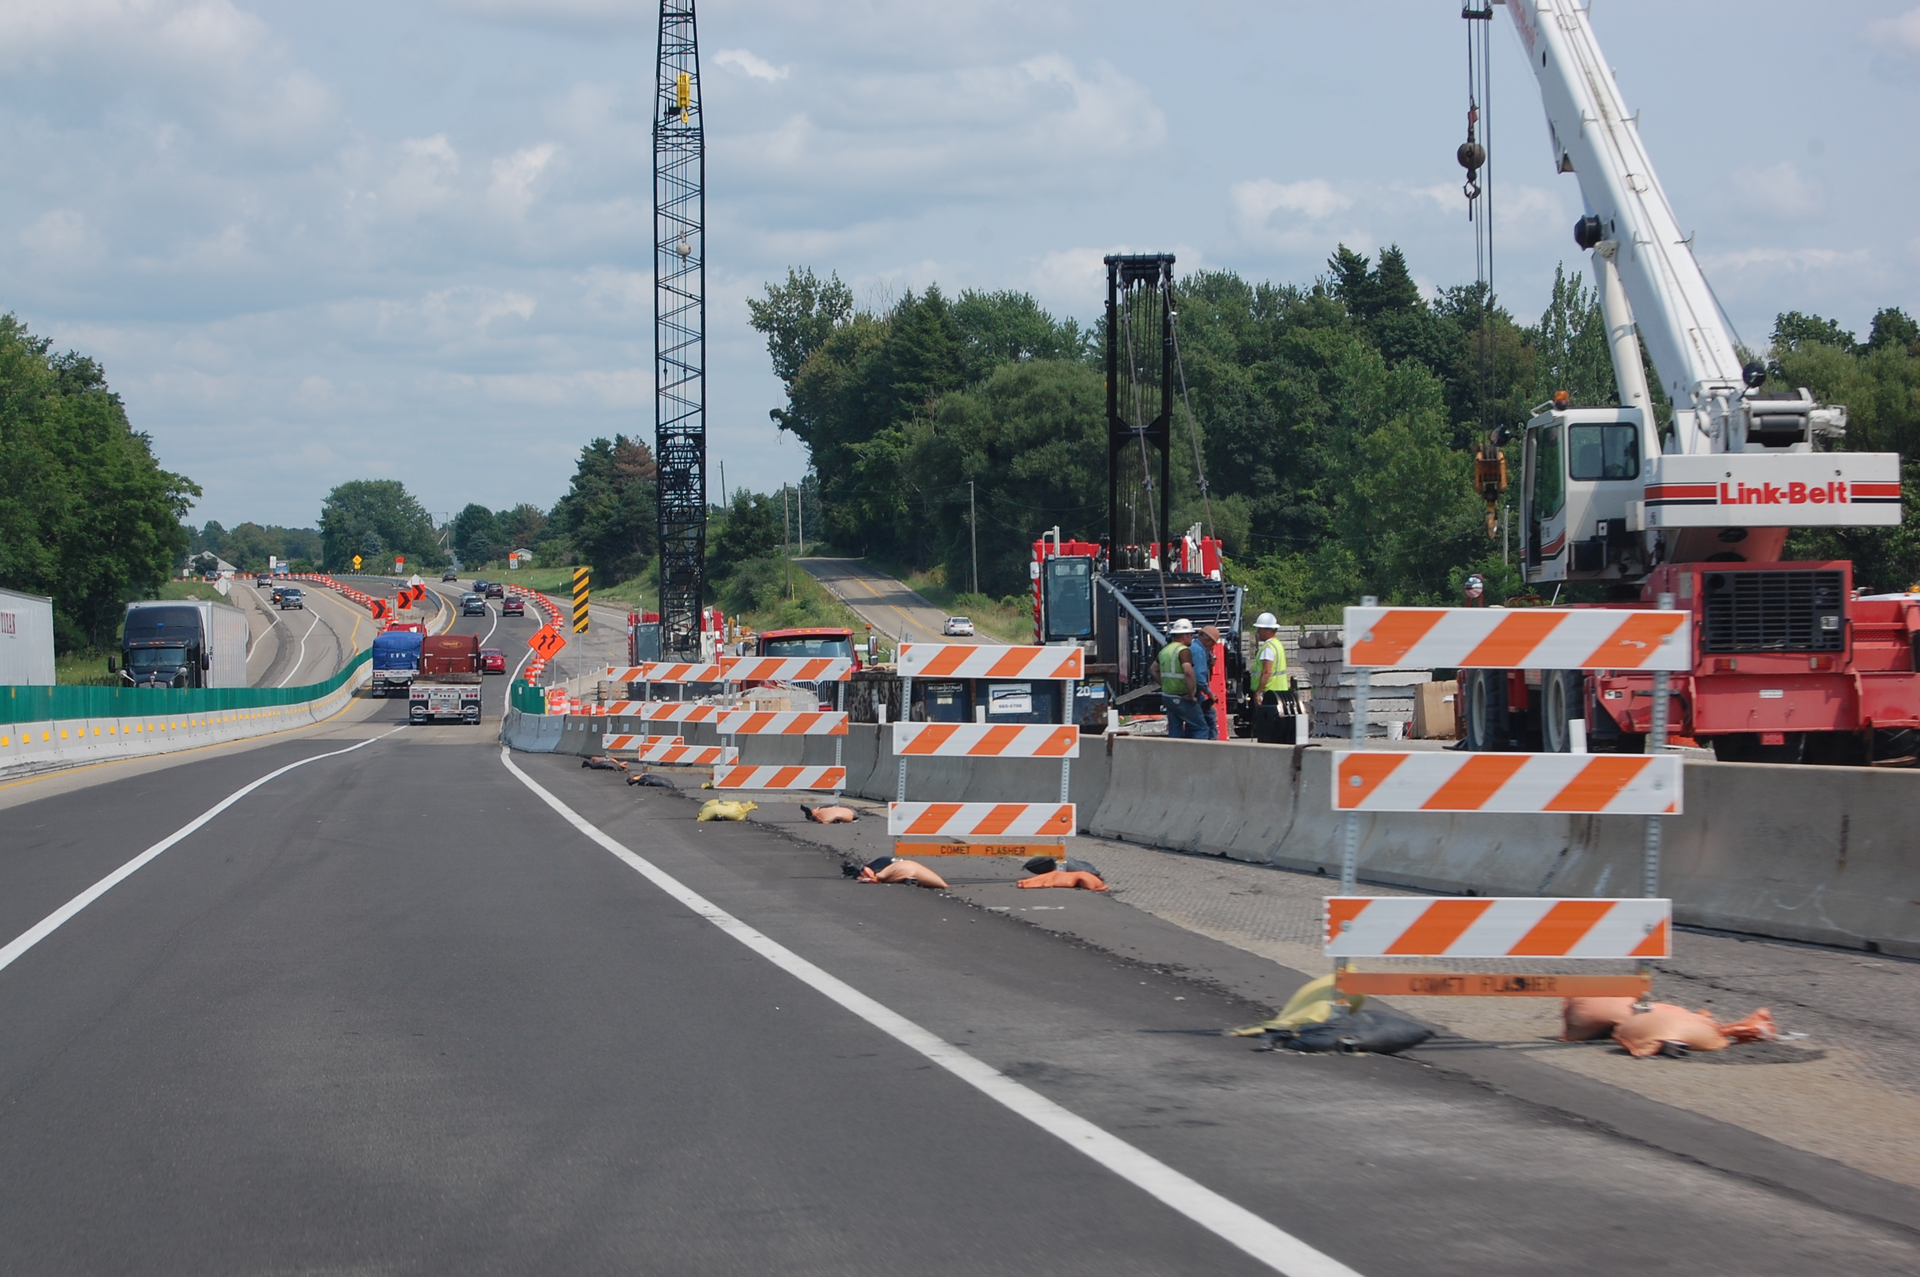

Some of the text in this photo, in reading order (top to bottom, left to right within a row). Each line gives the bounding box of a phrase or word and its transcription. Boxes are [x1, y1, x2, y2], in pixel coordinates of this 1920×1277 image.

[1719, 481, 1848, 505] Link-Belt
[1076, 686, 1091, 697] 20
[940, 845, 1026, 856] COMET FLASHER
